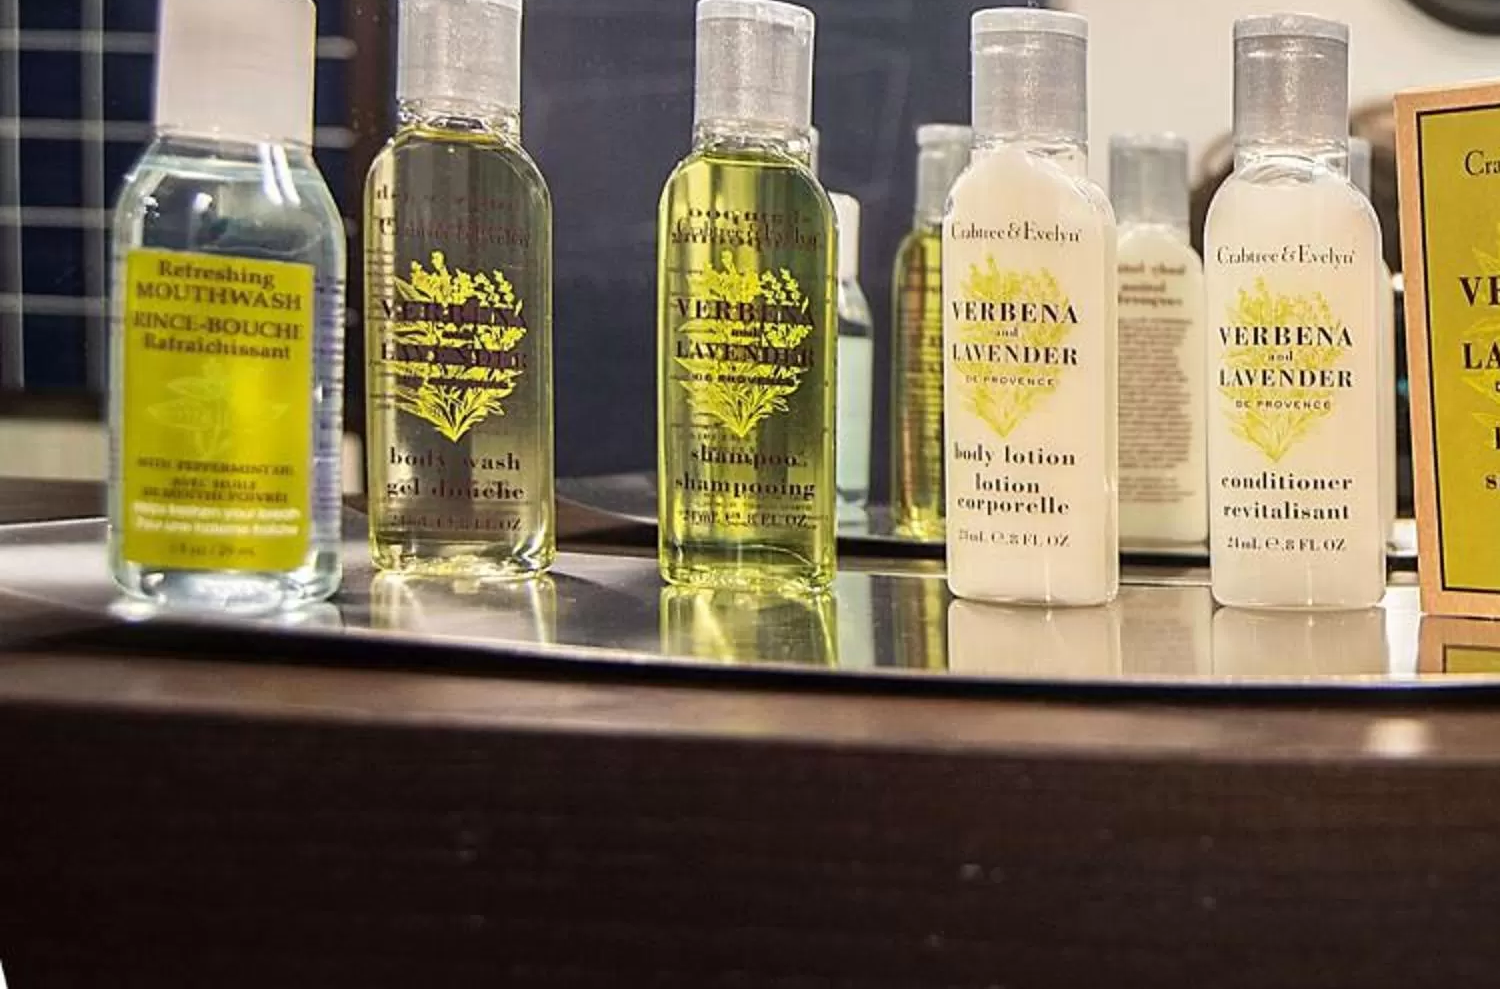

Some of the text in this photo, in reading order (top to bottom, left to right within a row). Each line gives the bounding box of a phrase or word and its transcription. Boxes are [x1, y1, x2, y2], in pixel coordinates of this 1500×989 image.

[951, 221, 1005, 240] Crabtree
[1024, 220, 1080, 247] Evelyn
[1217, 245, 1279, 264] Crabtree
[1299, 245, 1353, 269] Evelyn
[159, 259, 275, 290] Refreshing
[136, 281, 302, 311] MOUTHWASH
[677, 298, 815, 326] VERBENA
[952, 301, 1079, 324] VERBENA
[1219, 326, 1353, 346] VERBENA
[676, 341, 814, 367] LAVENDER
[953, 343, 1078, 365] LAVENDER
[1268, 351, 1293, 361] and
[984, 376, 1054, 386] PROVENCE
[1220, 368, 1352, 387] LAVENDER
[1257, 399, 1331, 409] PROVENCE
[464, 452, 520, 471] wash
[954, 442, 1076, 468] body lotion
[387, 479, 420, 497] gel
[675, 473, 815, 500] shampooing
[975, 472, 1039, 493] lotion
[1221, 471, 1352, 490] conditioner
[957, 496, 1069, 515] corporelle
[1223, 501, 1349, 519] revitalisant
[1047, 534, 1072, 547] OZ
[1323, 538, 1346, 550] OZ
